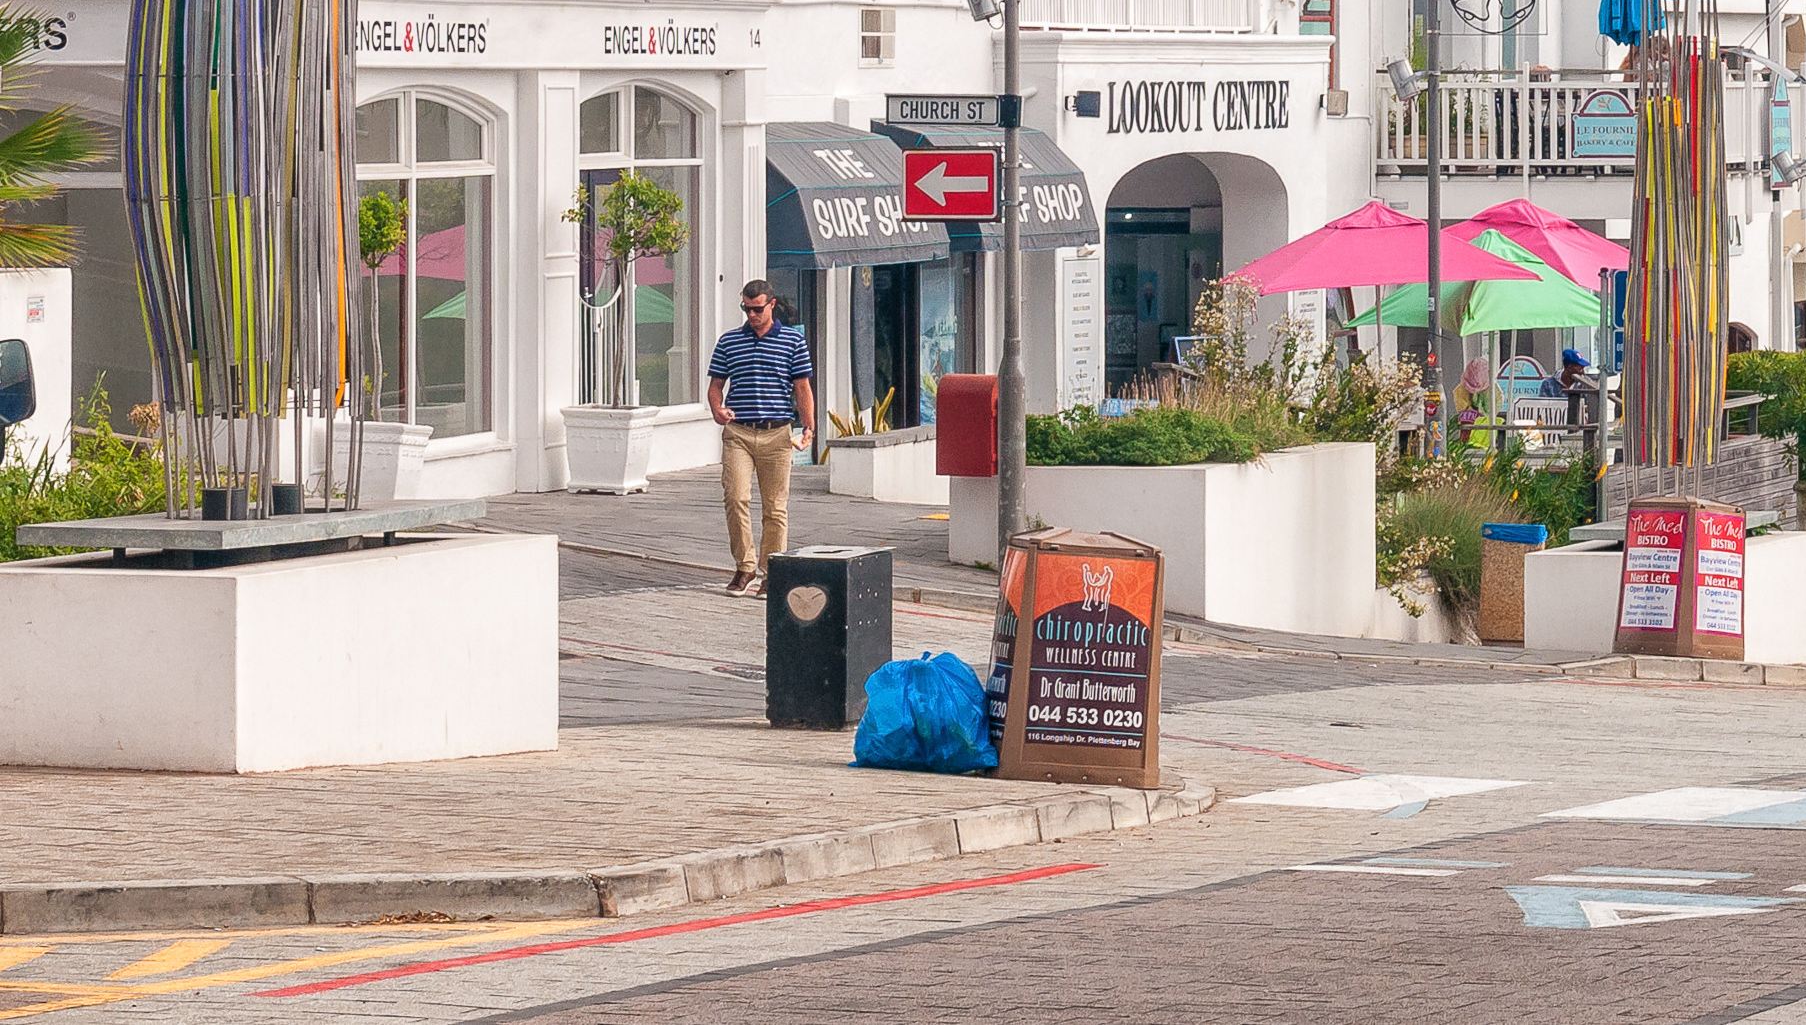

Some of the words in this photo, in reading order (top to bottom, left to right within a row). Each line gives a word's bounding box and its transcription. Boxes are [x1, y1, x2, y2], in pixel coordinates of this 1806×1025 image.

[900, 101, 960, 119] CHURCH
[967, 101, 985, 120] ST
[1107, 81, 1205, 134] LOOKOUT
[1212, 79, 1290, 132] CENTRE
[813, 149, 875, 180] THE
[1033, 182, 1084, 224] SHOP
[813, 197, 871, 240] SURF
[1632, 515, 1650, 533] The
[1652, 515, 1683, 535] Med
[1700, 517, 1722, 536] The
[1637, 535, 1669, 546] BISTRO
[1710, 537, 1737, 551] BISTRO
[1653, 553, 1678, 562] Centre
[1630, 573, 1649, 583] Next
[1650, 573, 1671, 583] Left
[1704, 575, 1726, 587] Next
[1726, 577, 1739, 590] Left
[1630, 585, 1644, 594] Open
[1655, 586, 1669, 595] Day
[1704, 588, 1722, 598] Open
[1037, 611, 1148, 648] chiropractic
[1046, 647, 1097, 666] WELLNESS
[1101, 650, 1137, 668] CENTRE
[1040, 677, 1052, 699] Dr
[1054, 677, 1081, 701] Grant
[1083, 679, 1136, 704] Butterworth
[1028, 704, 1062, 723] 044
[1066, 706, 1099, 725] 533
[1103, 709, 1143, 728] 0230
[1027, 732, 1040, 741] 116
[1041, 733, 1076, 746] Longship
[1076, 735, 1087, 744] Dr.
[1088, 735, 1127, 748] Plettenberg
[1127, 738, 1141, 749] Bay
